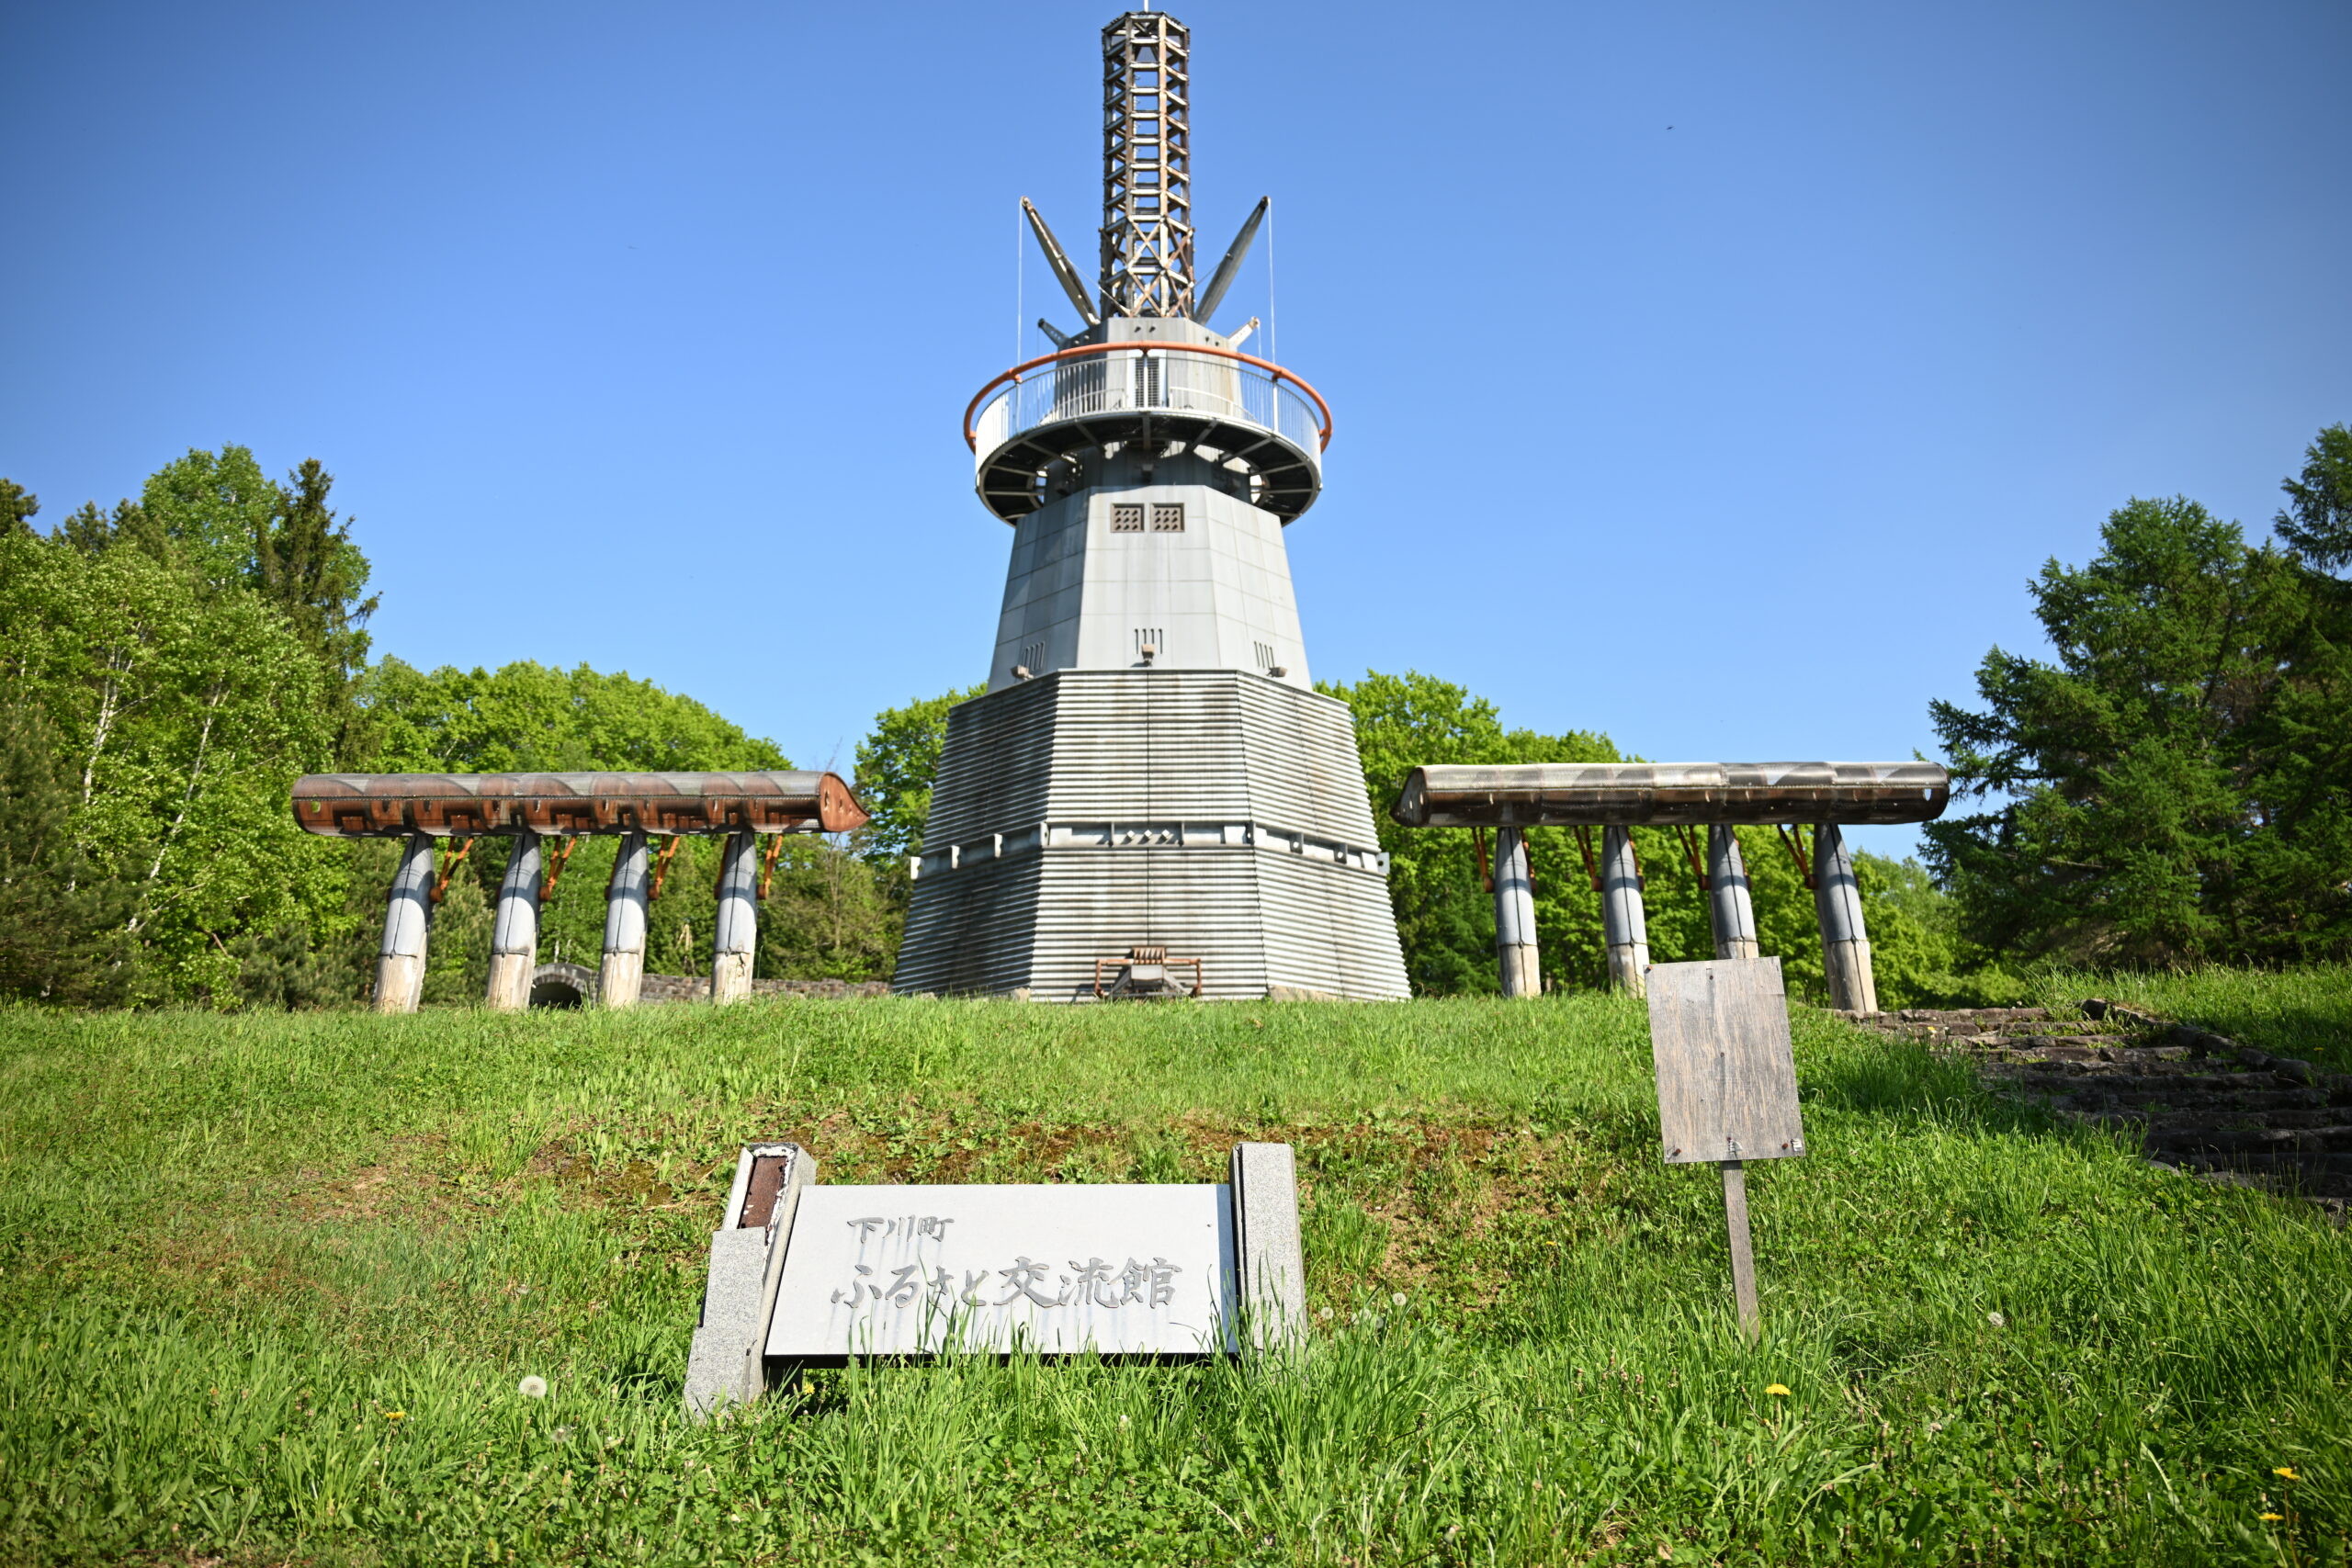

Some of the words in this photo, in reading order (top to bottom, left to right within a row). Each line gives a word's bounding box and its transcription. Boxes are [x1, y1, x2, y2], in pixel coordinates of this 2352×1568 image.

[846, 1214, 955, 1243] 下川町
[831, 1256, 1182, 1310] ふるさと交流館
